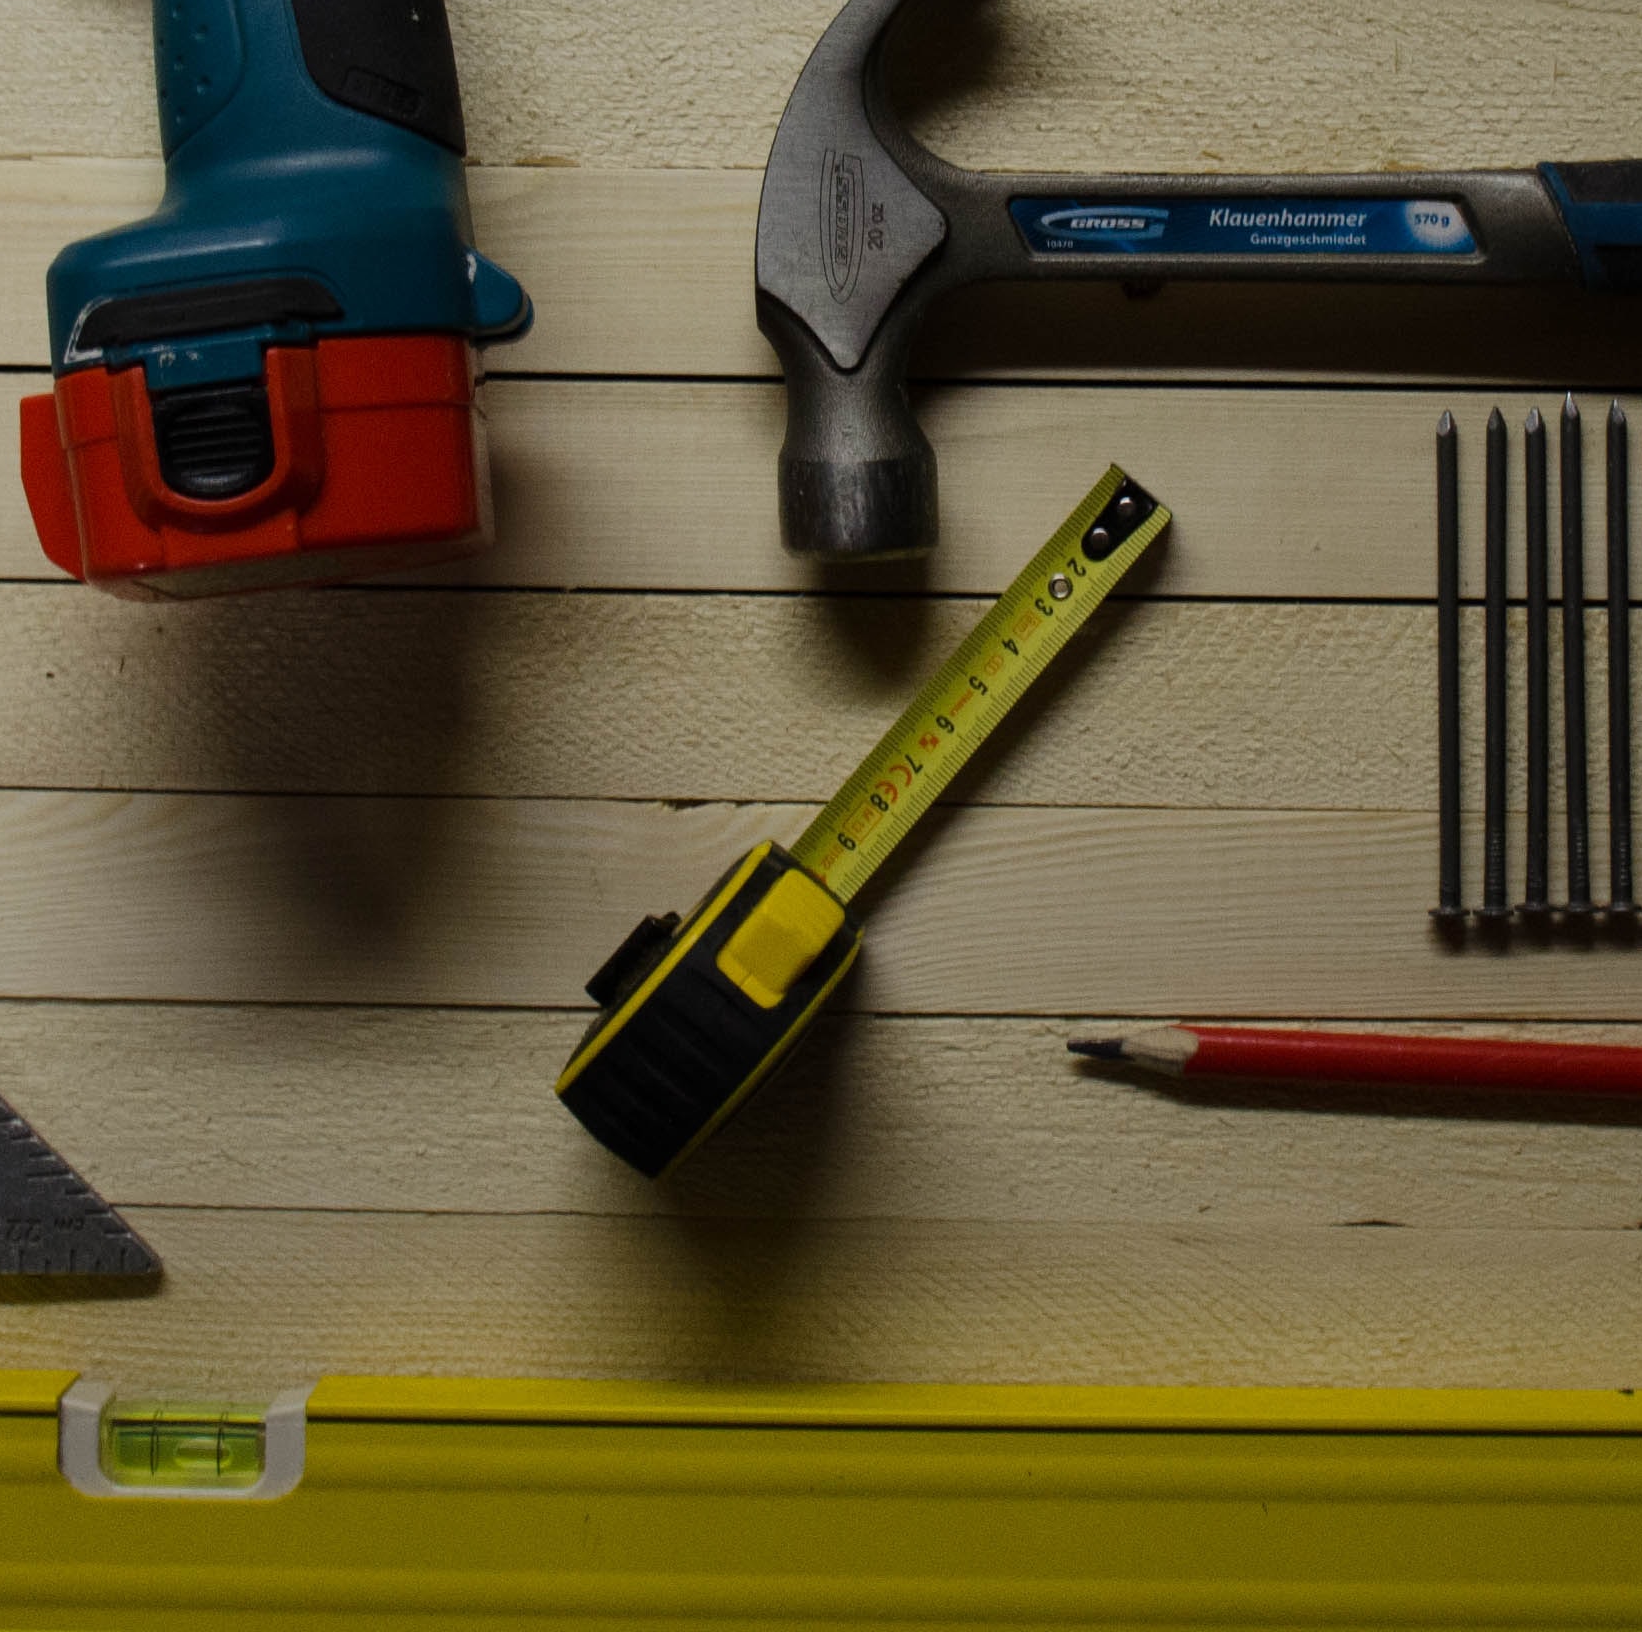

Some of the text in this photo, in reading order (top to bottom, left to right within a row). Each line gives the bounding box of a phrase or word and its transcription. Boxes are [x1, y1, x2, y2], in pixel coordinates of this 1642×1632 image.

[867, 201, 885, 251] 20 oz
[1069, 217, 1147, 230] GROSS
[1208, 208, 1368, 228] Klauenhammer
[1414, 212, 1451, 228] 570 g
[1249, 233, 1367, 248] Ganzgeschmiedet
[1066, 556, 1088, 579] 2
[1033, 596, 1055, 618] 3
[1000, 636, 1020, 658] 4
[967, 675, 989, 697] 5
[935, 714, 957, 735] 6
[904, 752, 924, 776] 7
[869, 792, 891, 814] 8
[836, 832, 857, 853] 9
